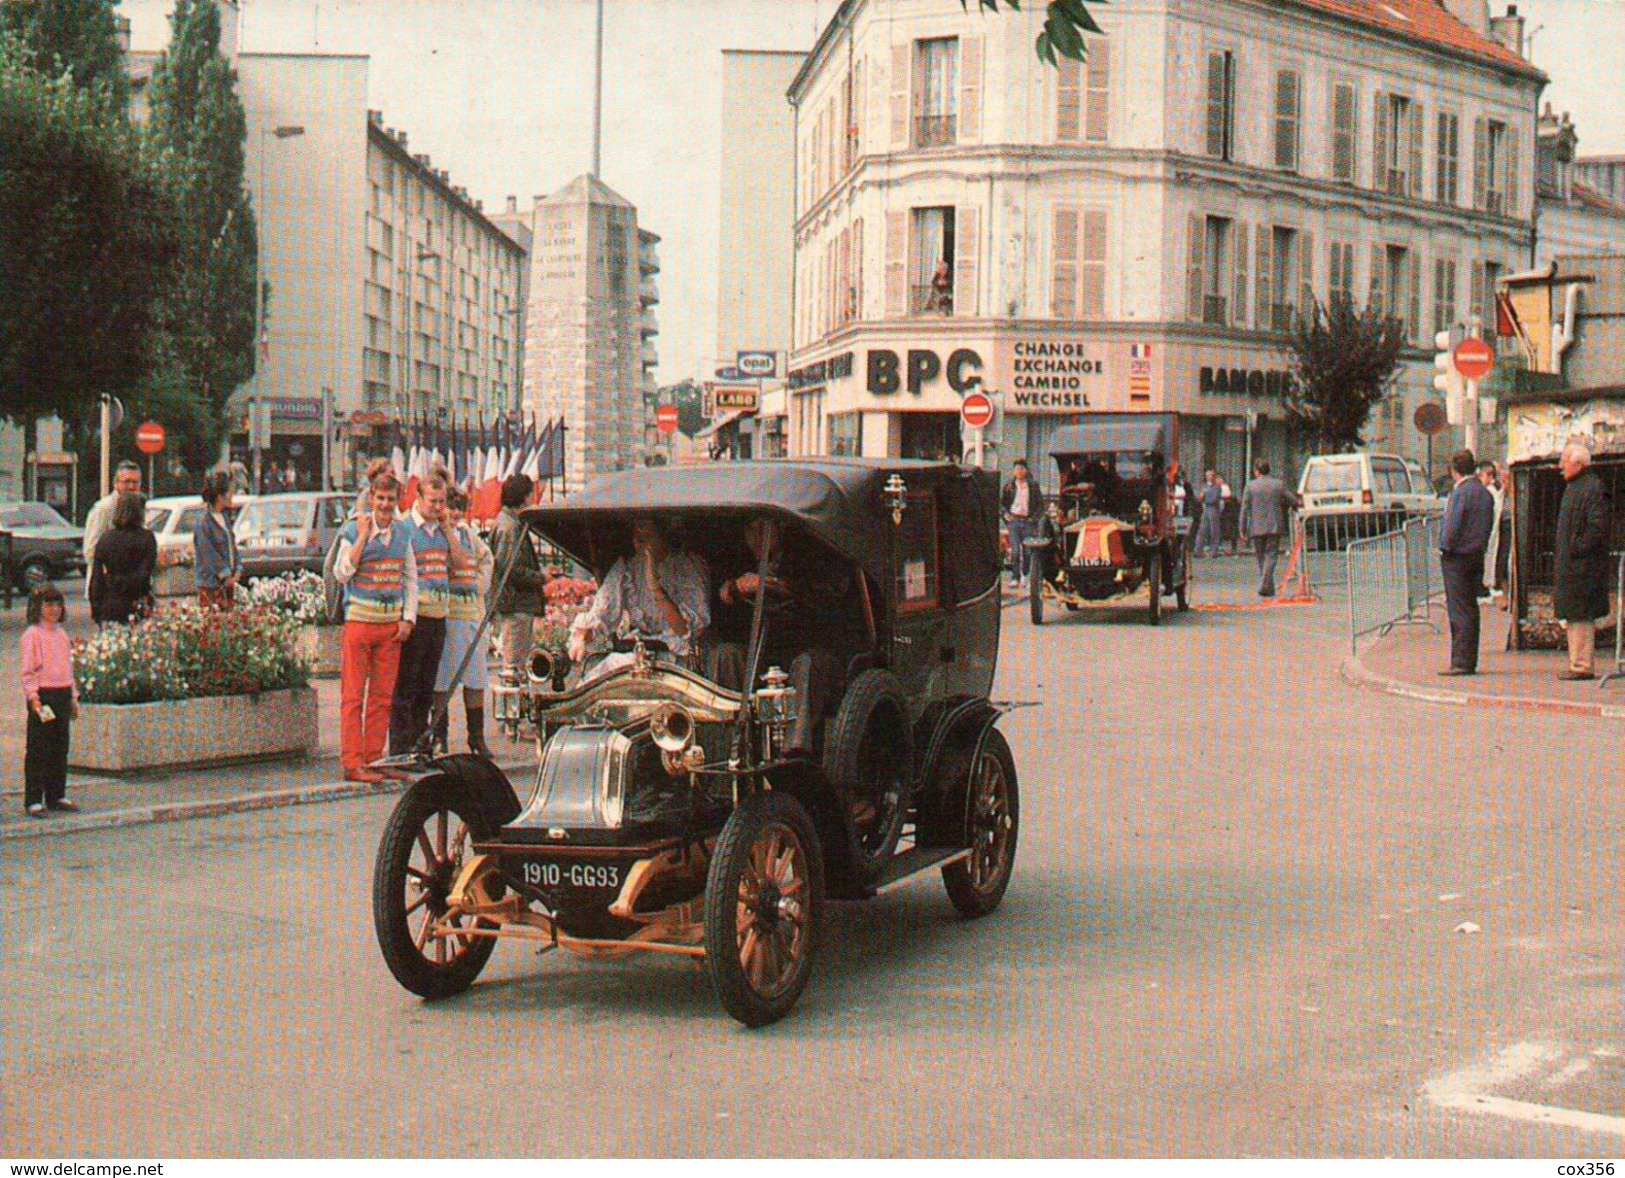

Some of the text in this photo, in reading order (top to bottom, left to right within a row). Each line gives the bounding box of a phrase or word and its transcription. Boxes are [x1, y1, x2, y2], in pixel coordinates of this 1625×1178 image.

[1014, 343, 1084, 357] CHANGE
[1014, 359, 1103, 374] EXCHANGE
[1014, 376, 1080, 389] CAMBIO
[1014, 392, 1091, 406] WECHSEL
[523, 862, 618, 887] 1910-GG93
